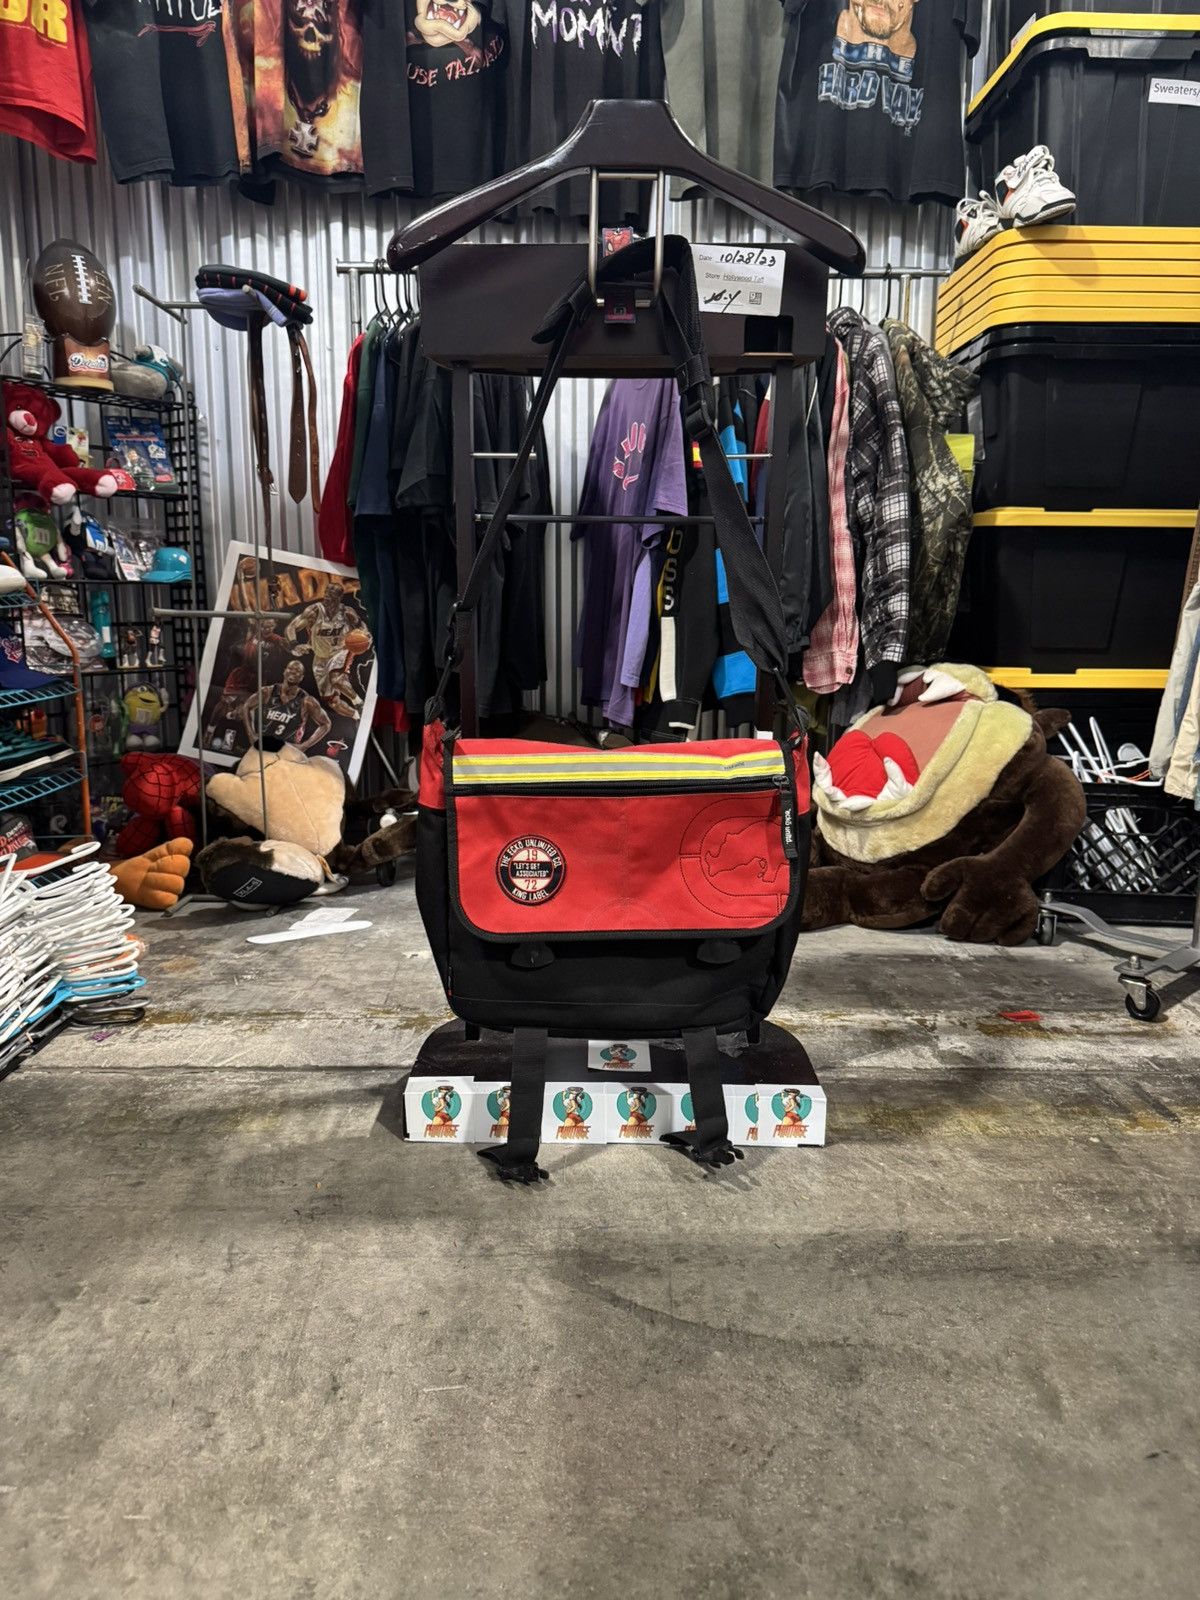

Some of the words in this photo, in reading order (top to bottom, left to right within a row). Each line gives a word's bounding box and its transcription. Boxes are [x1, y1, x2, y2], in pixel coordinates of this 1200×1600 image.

[818, 62, 880, 111] HARD
[720, 248, 776, 267] 10/28/23
[266, 709, 297, 723] HEAT
[275, 724, 286, 736] 3
[526, 849, 538, 861] 19
[524, 879, 537, 890] 72
[512, 887, 528, 900] KING
[529, 889, 548, 900] LABEL
